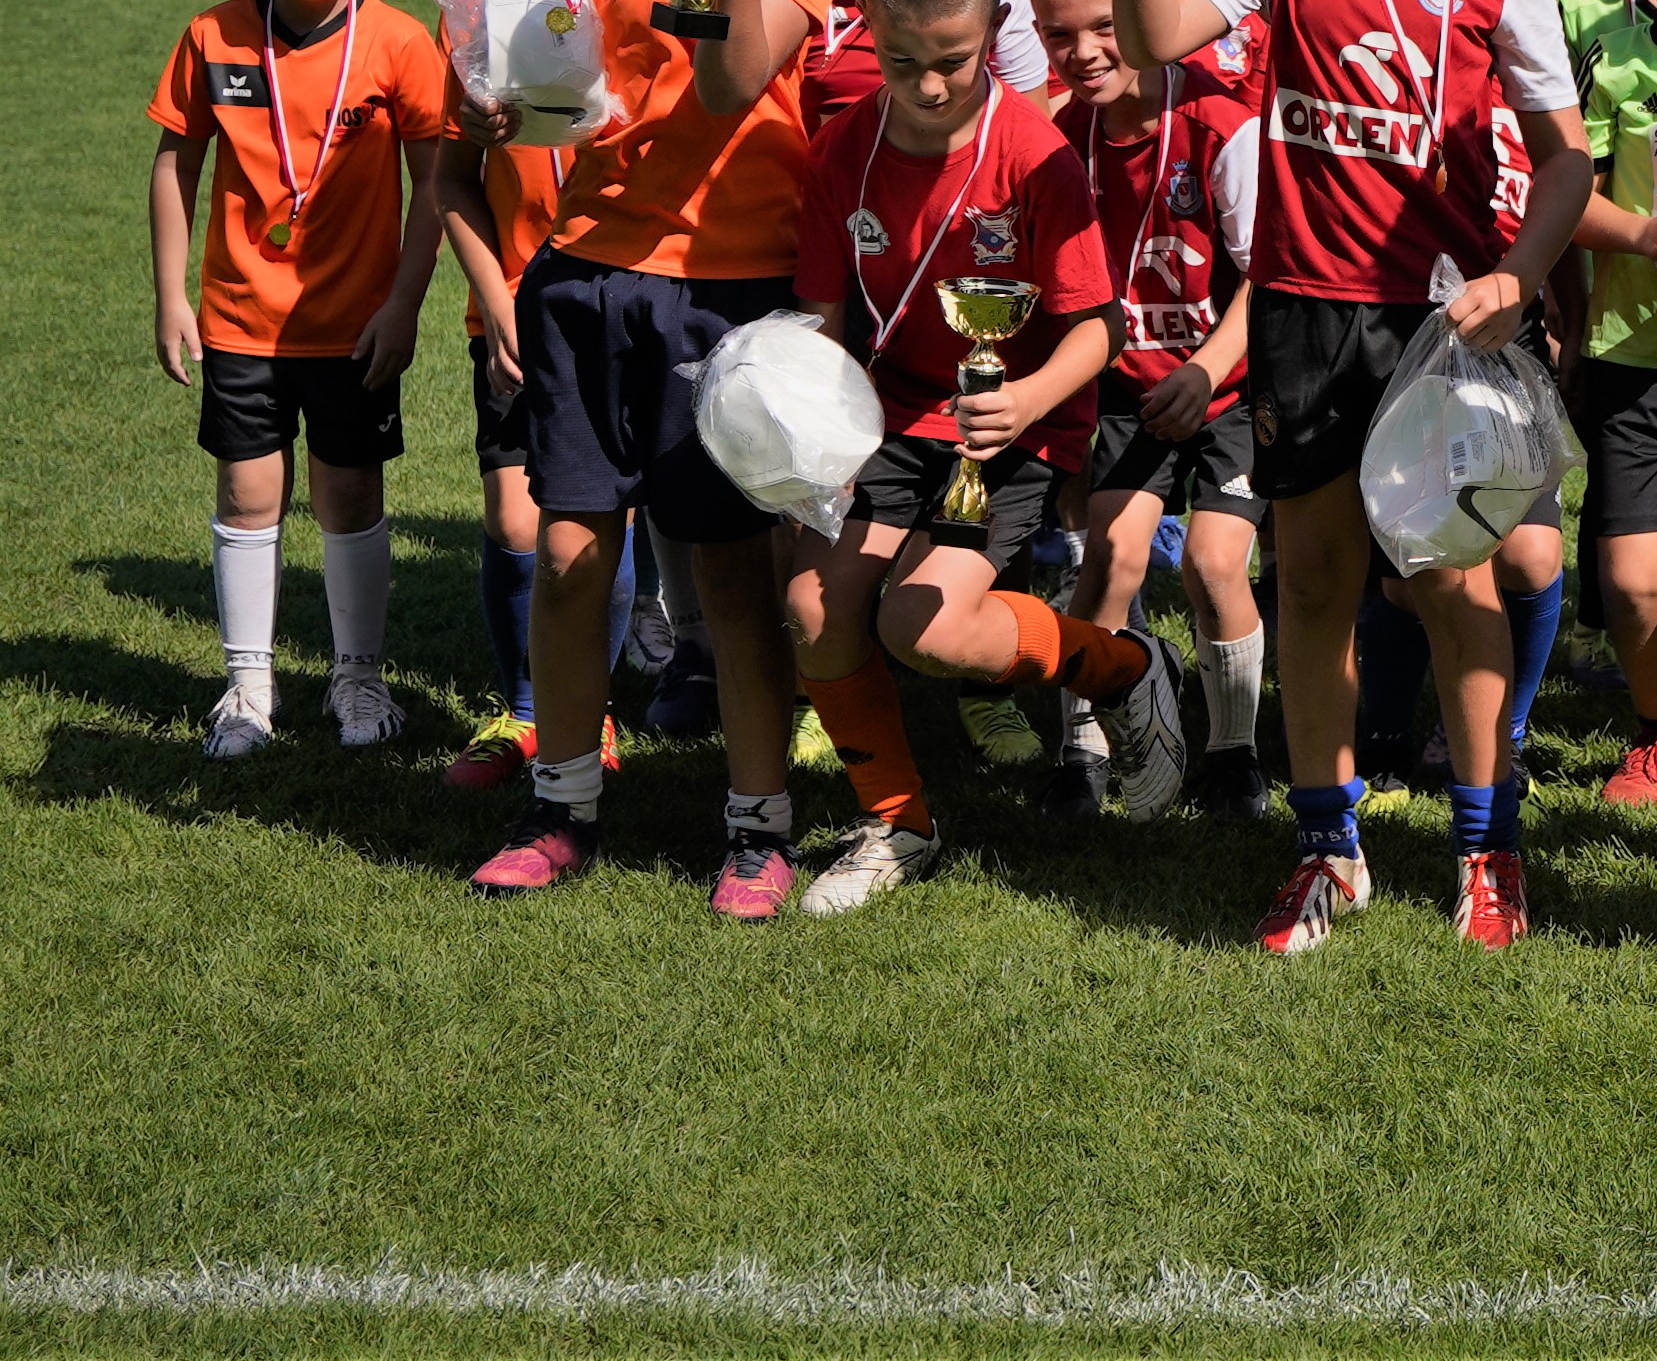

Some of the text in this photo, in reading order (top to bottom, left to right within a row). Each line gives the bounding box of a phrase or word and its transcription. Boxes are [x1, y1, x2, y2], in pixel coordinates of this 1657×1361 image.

[1282, 99, 1421, 156] ORLEN
[1126, 304, 1212, 345] RLEN
[1220, 485, 1254, 500] adidas
